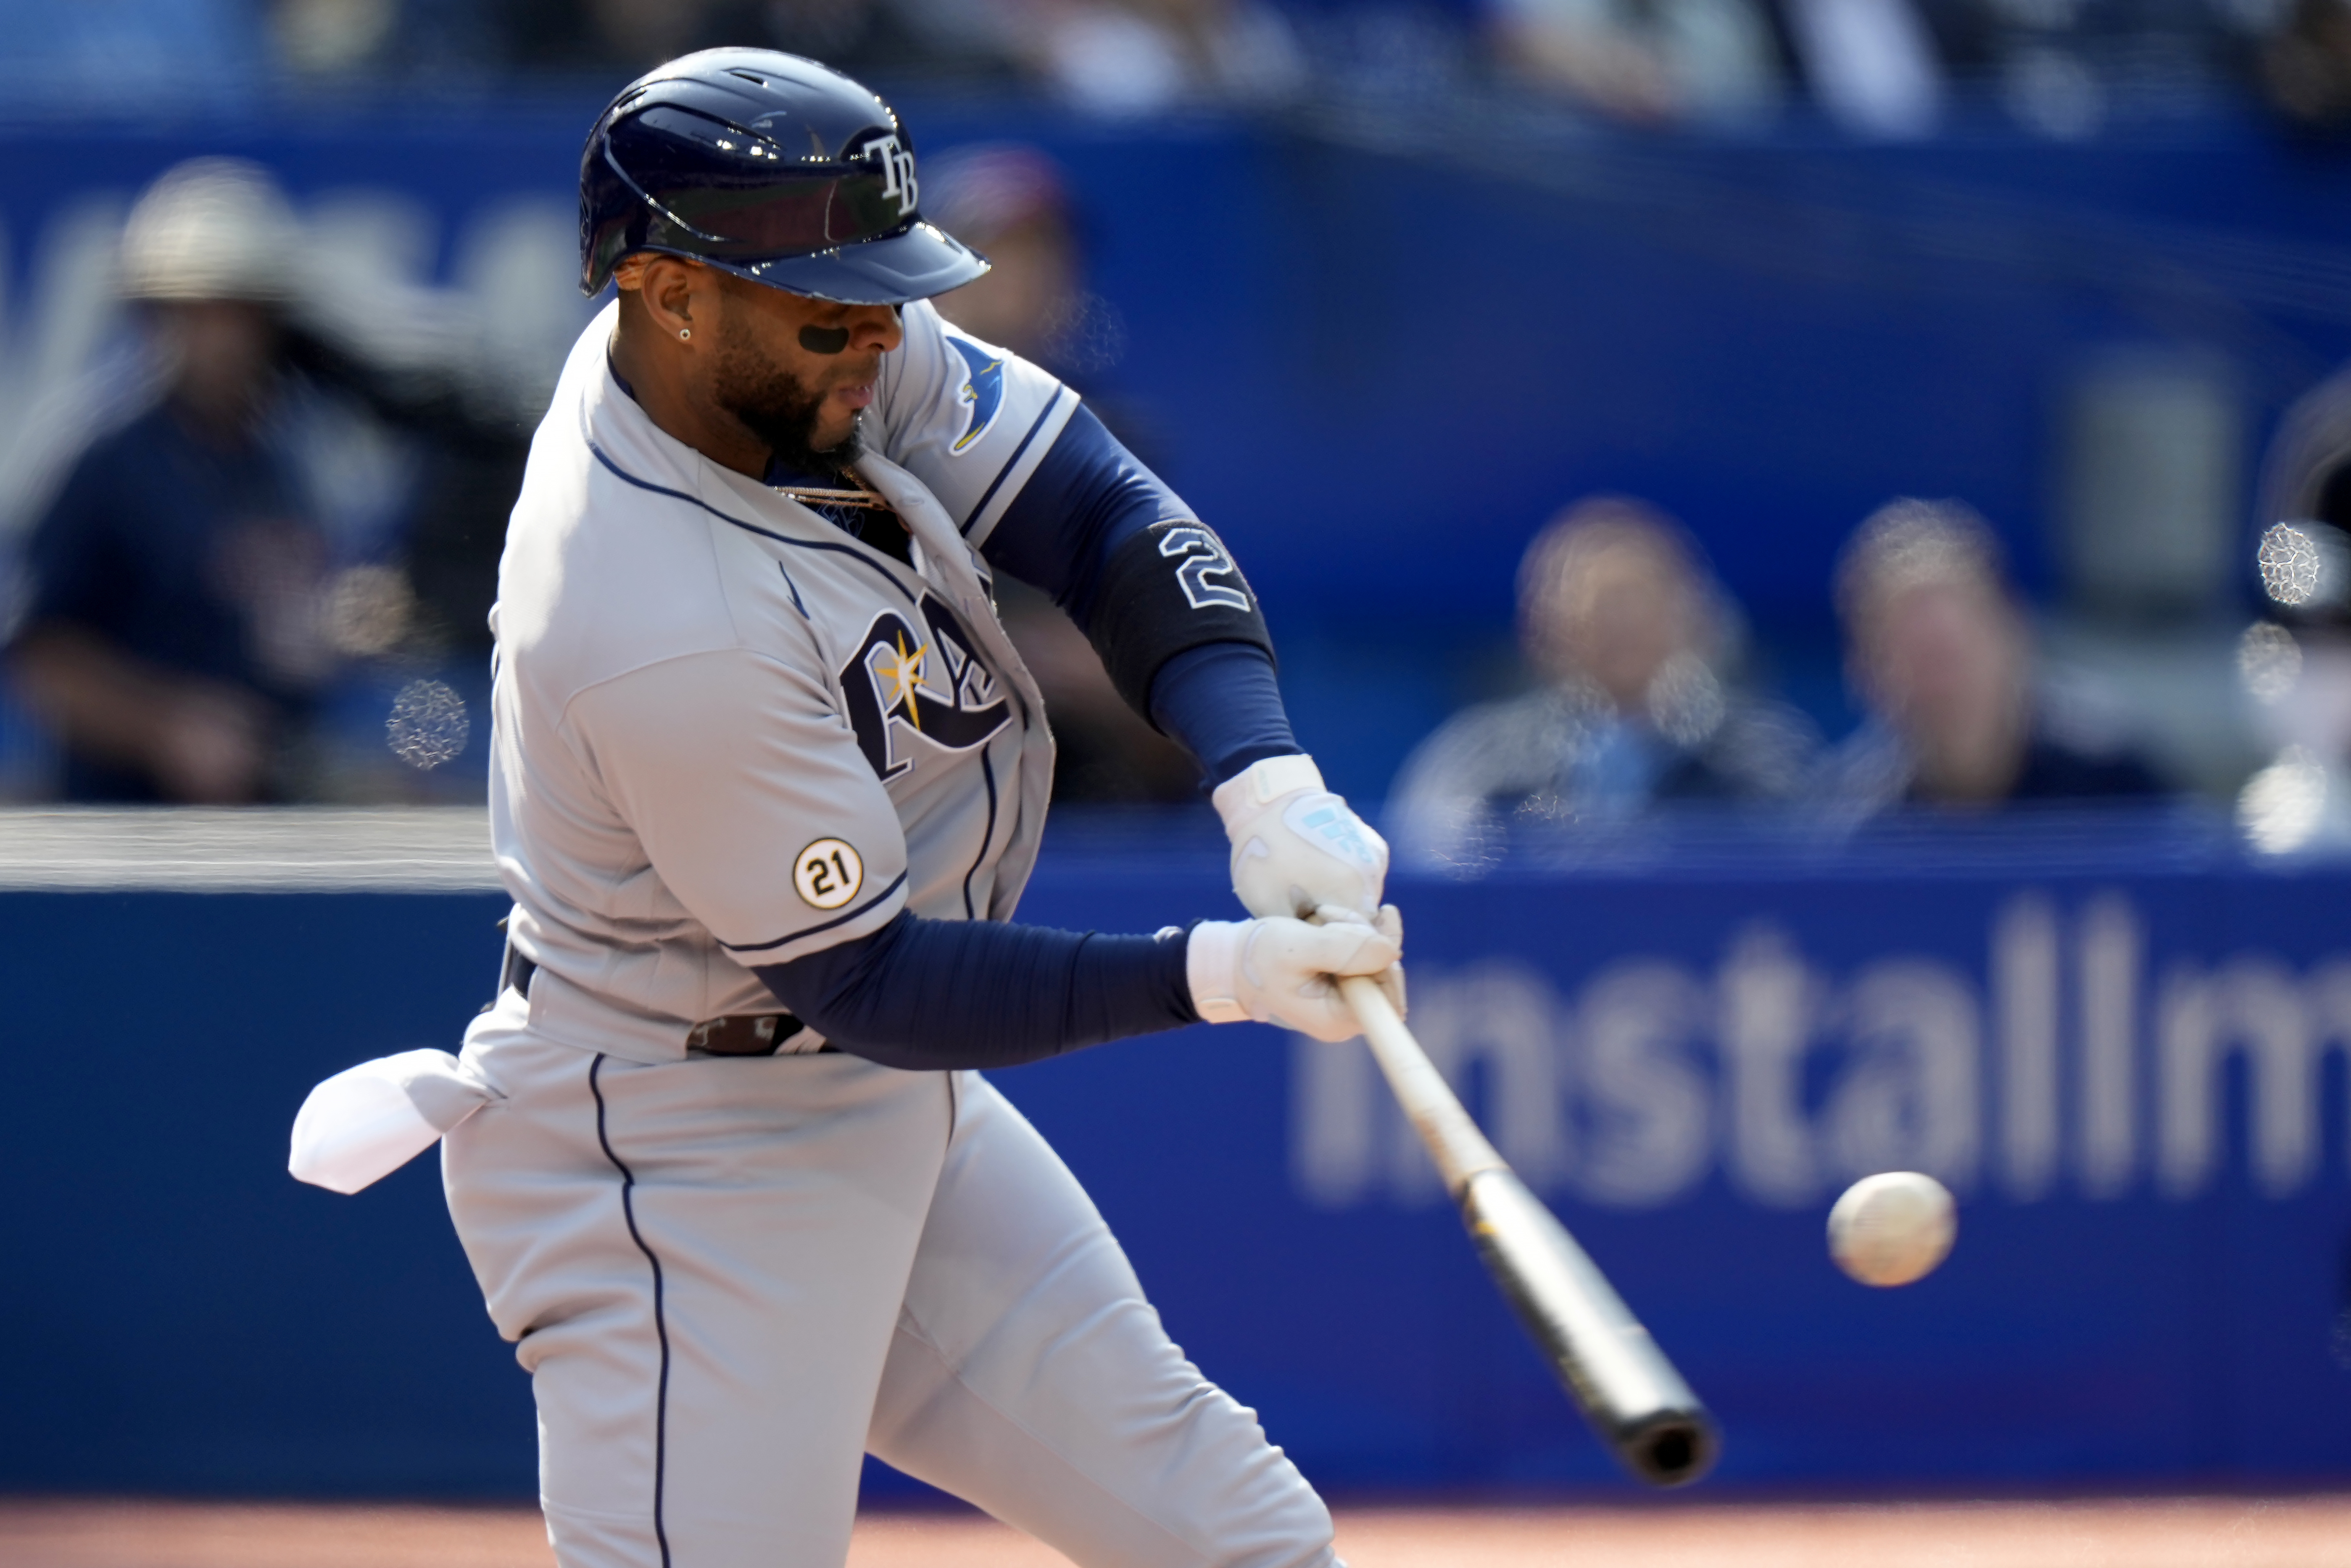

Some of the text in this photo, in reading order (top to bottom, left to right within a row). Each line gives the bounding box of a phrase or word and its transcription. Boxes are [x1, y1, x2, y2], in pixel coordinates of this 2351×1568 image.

[863, 133, 919, 216] TB
[1159, 527, 1251, 613] 2
[806, 849, 851, 896] 21
